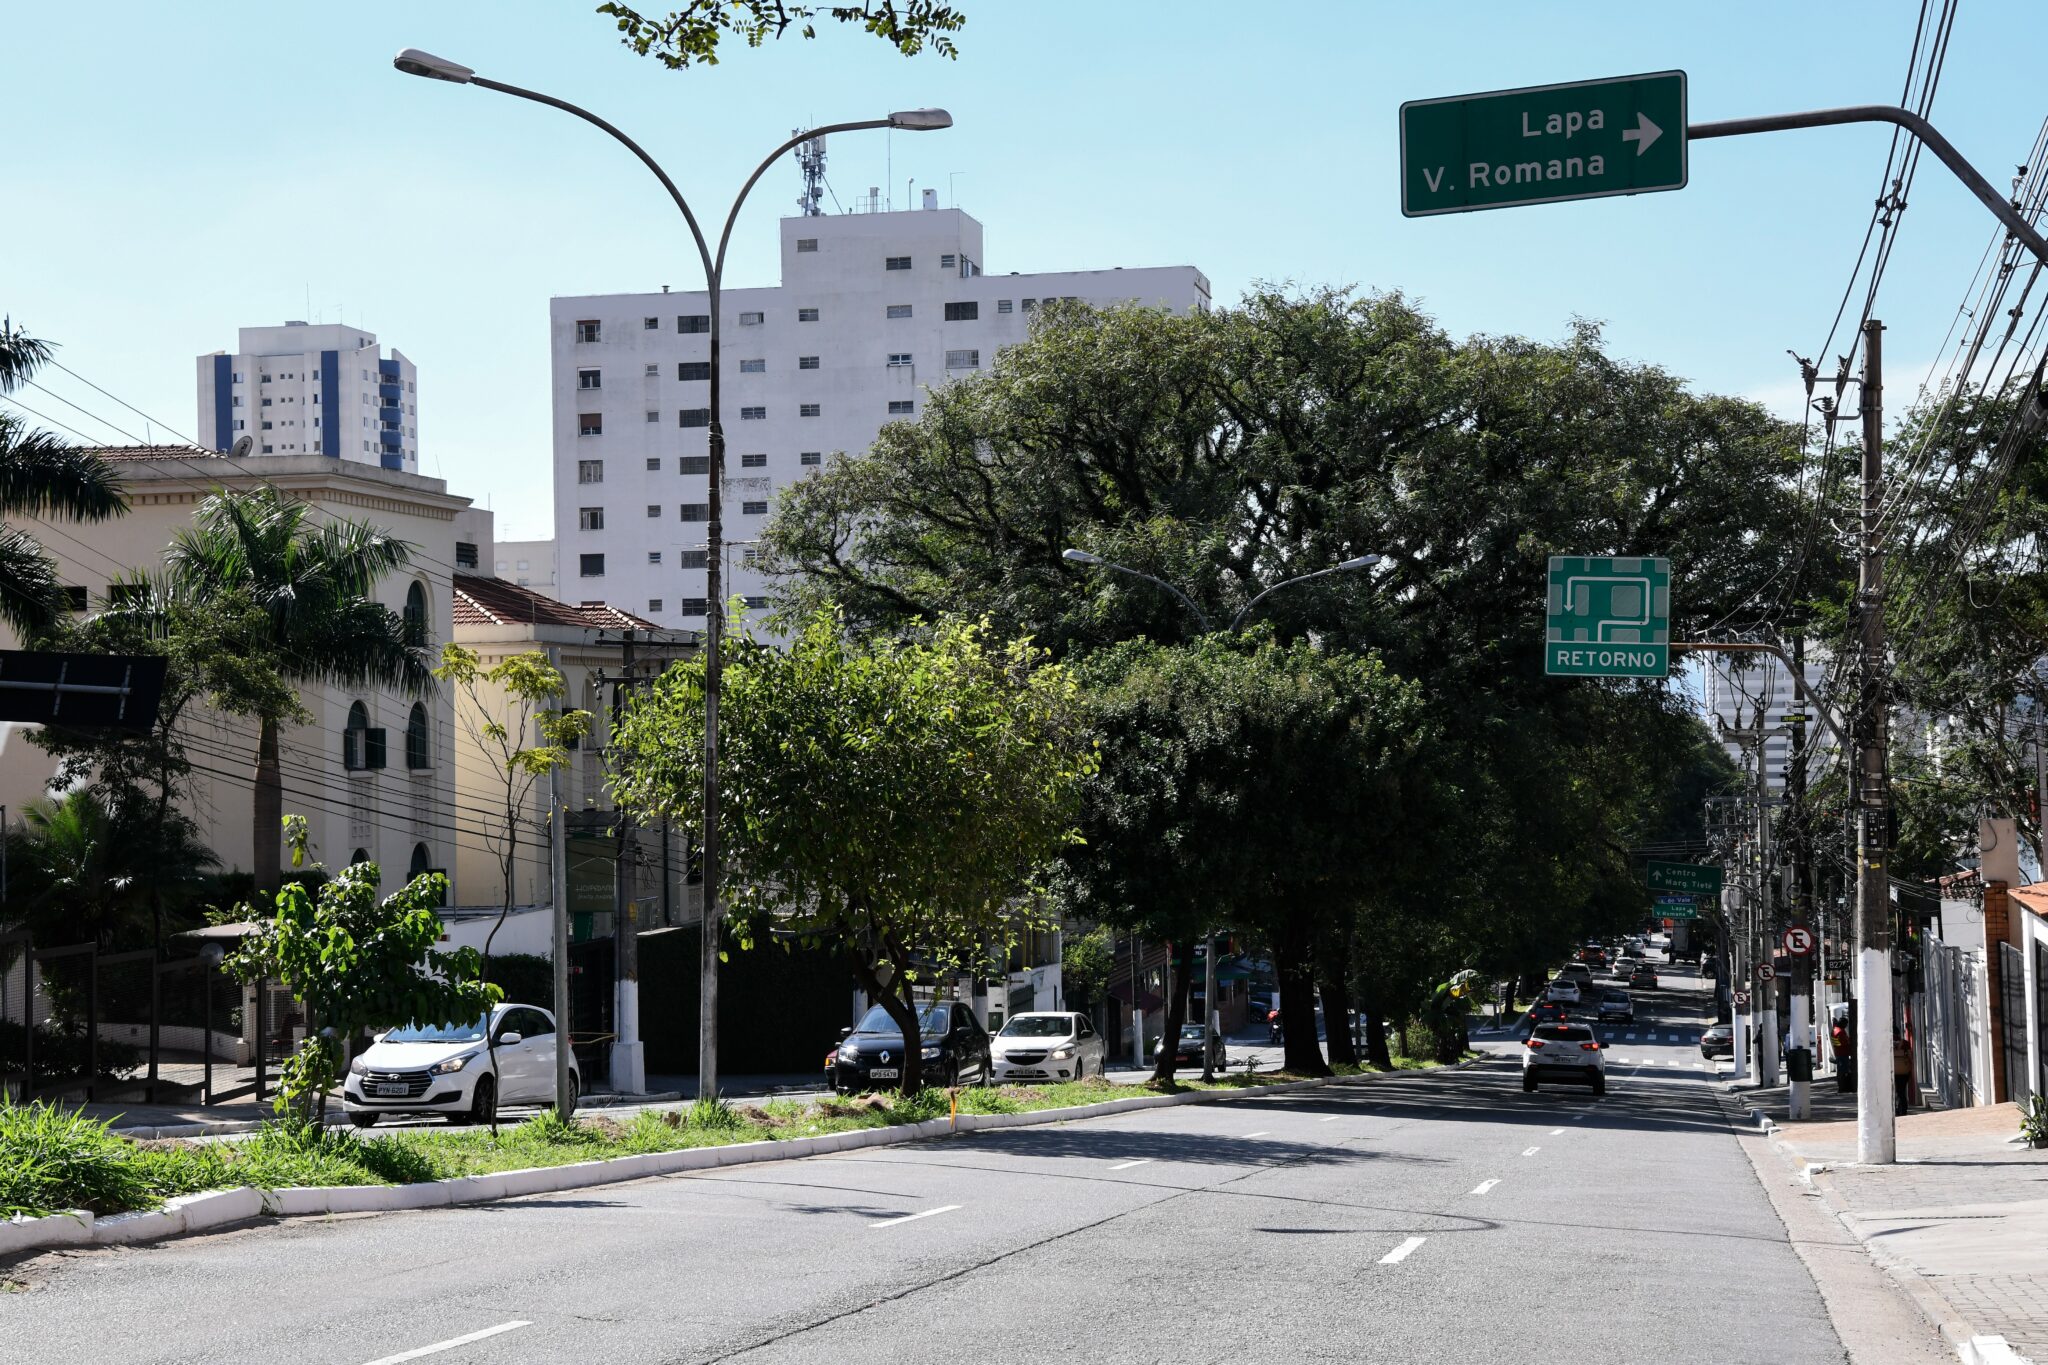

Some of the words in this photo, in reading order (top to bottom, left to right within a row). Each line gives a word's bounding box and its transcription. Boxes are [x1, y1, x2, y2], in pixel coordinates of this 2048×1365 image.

[1522, 109, 1604, 139] Lapa
[1422, 166, 1455, 193] V.
[1469, 155, 1605, 188] Romana
[1557, 650, 1656, 668] RETORNO
[1666, 868, 1696, 877] Centro
